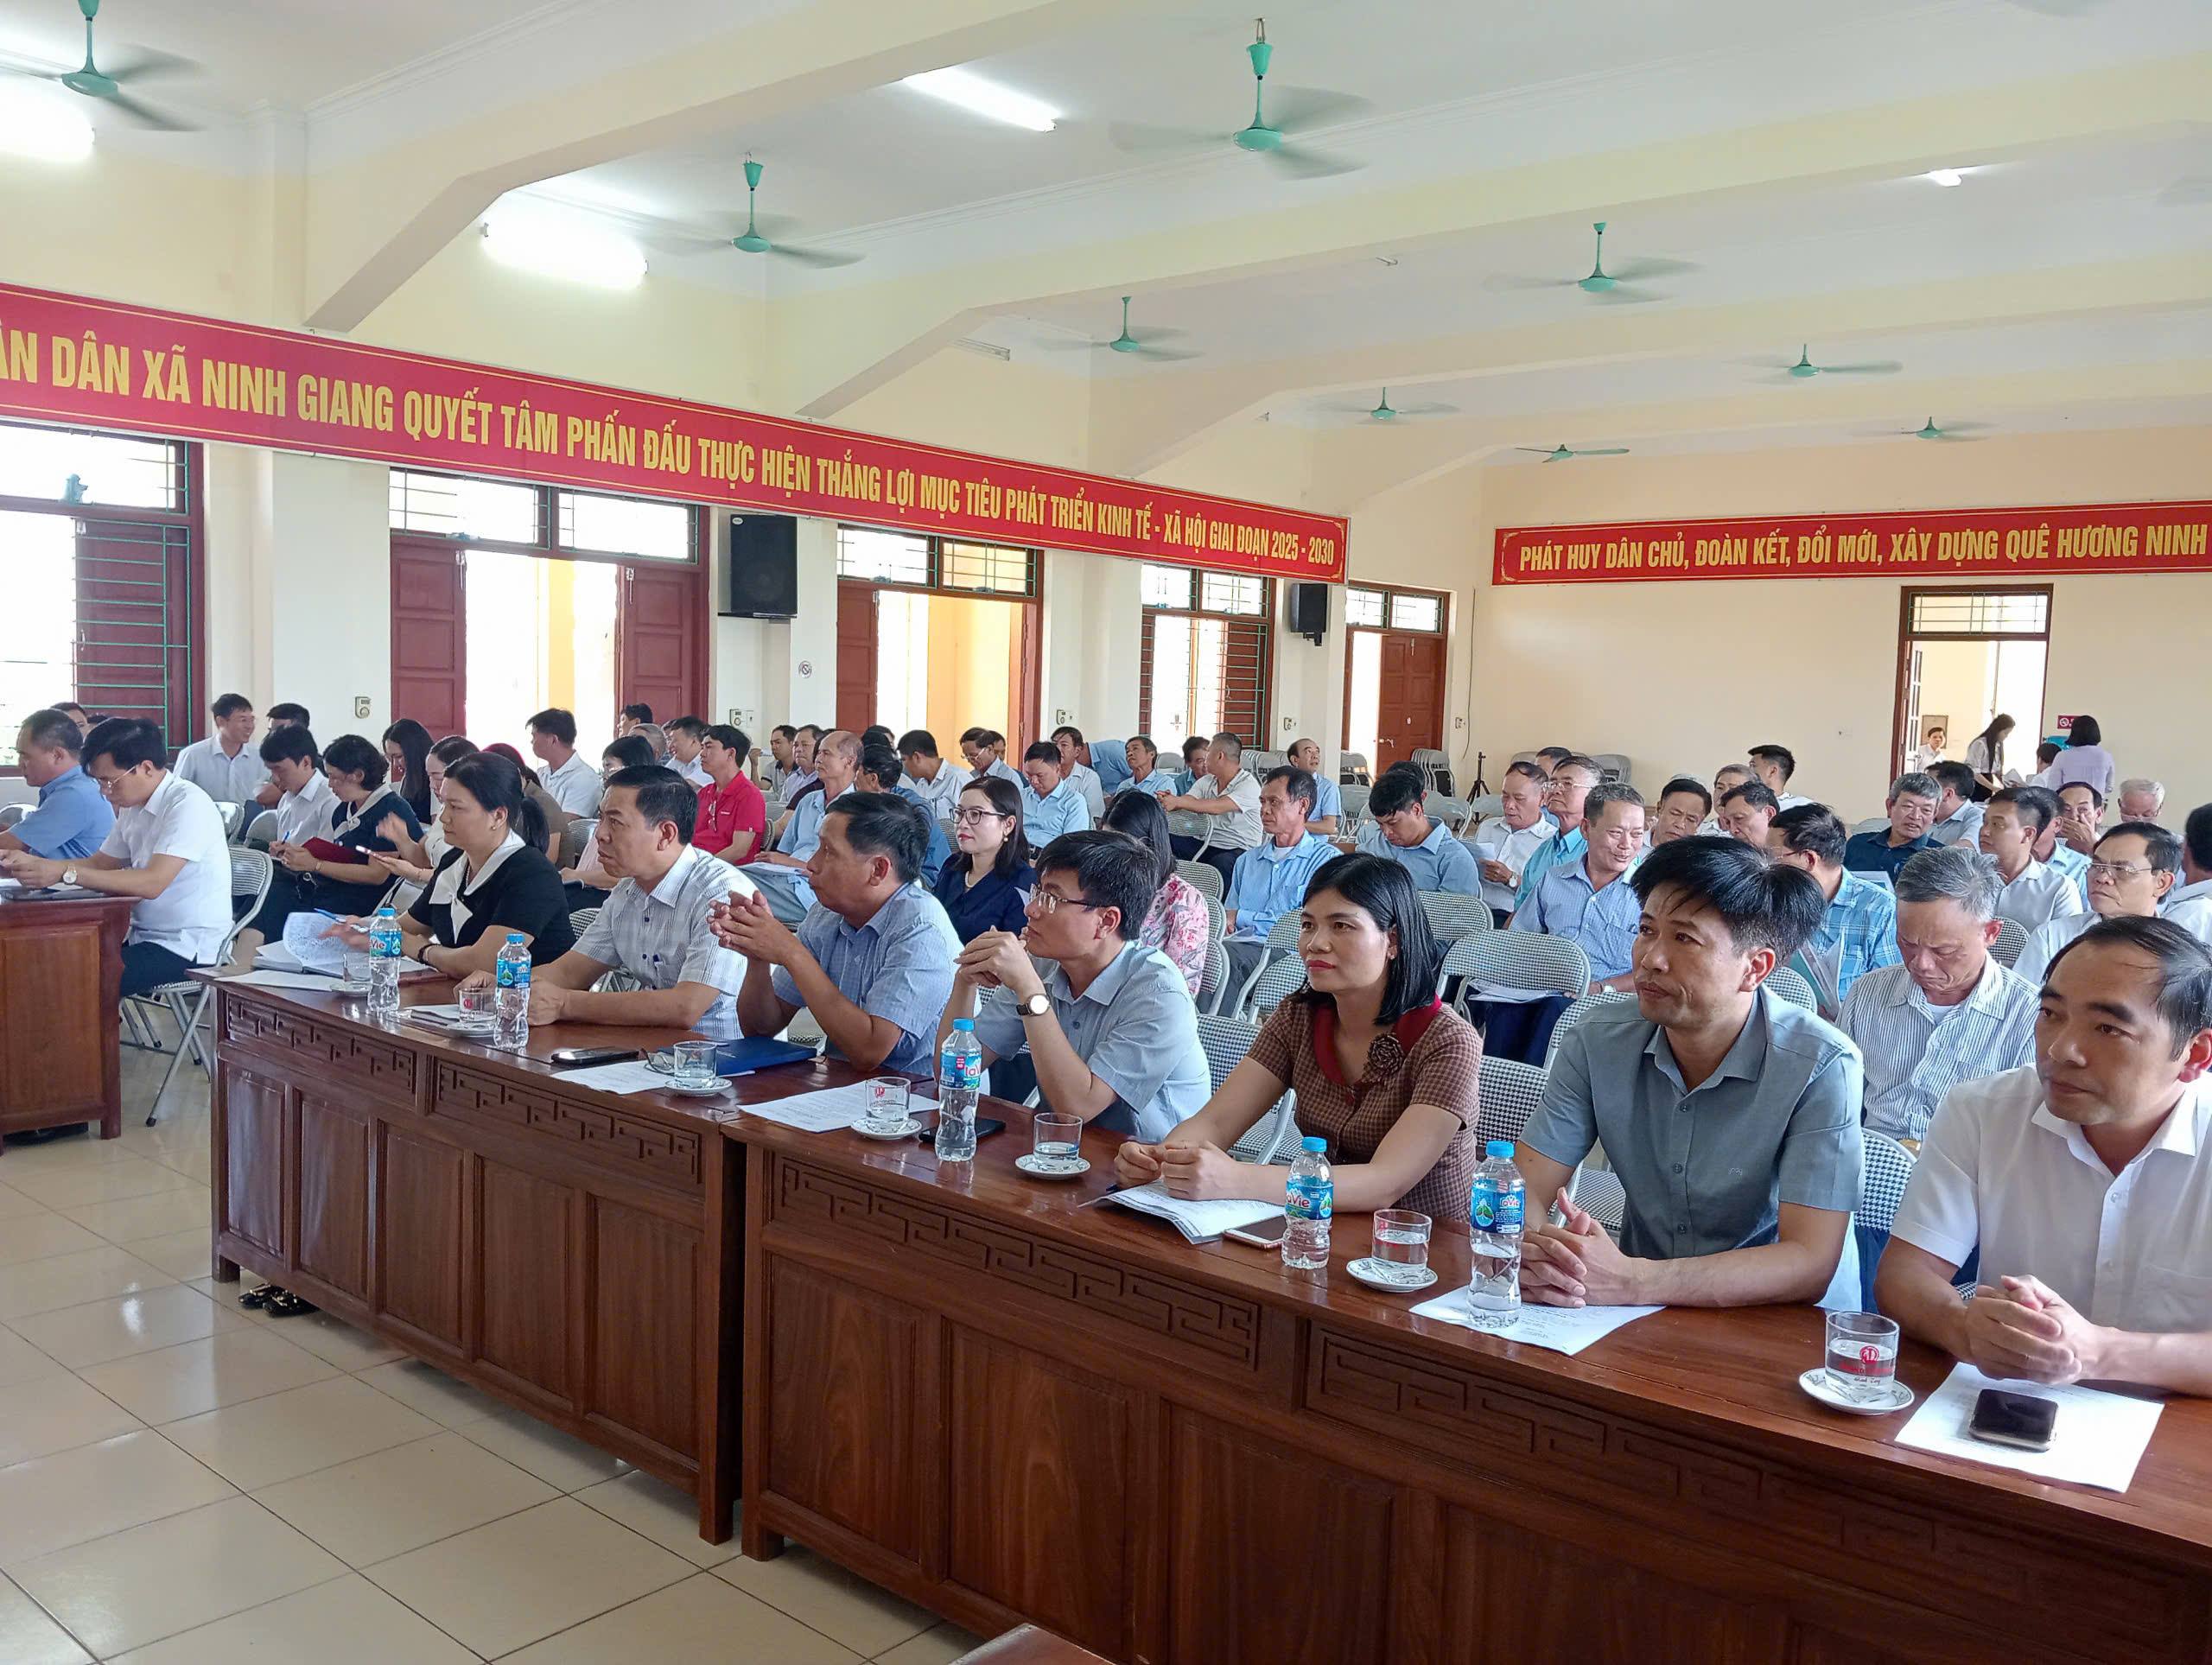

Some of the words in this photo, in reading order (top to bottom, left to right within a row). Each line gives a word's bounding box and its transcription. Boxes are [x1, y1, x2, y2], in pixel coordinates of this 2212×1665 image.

[52, 330, 130, 396] DÂN
[142, 344, 191, 404] XÃ
[202, 359, 286, 417] NINH
[297, 373, 394, 432] GIANG
[404, 387, 493, 445] QUYẾT
[500, 399, 558, 455] TÂM
[567, 409, 636, 467] PHẤN
[643, 419, 691, 474] ĐẤU
[698, 437, 755, 490] THỰC
[761, 444, 810, 499] HIỆN
[817, 449, 880, 503] THẮNG
[887, 468, 915, 514] LỢI
[920, 474, 961, 519] MỤC
[965, 477, 1001, 519] TIÊU
[1005, 485, 1047, 525] PHÁT
[1050, 486, 1095, 533] TRIỂN
[1096, 502, 1132, 538] KINH
[1135, 501, 1154, 541] TẾ
[1163, 509, 1182, 545] XÃ
[1185, 512, 1206, 554] HỘI
[1209, 520, 1235, 552] GIAI
[1236, 524, 1269, 562] ĐOẠN
[1270, 531, 1299, 562] 2025
[1307, 537, 1335, 566] 2030
[1519, 536, 1563, 572] PHÁT
[1567, 543, 1602, 570] HUY
[1605, 537, 1643, 569] DÂN
[1648, 531, 1690, 571] CHỦ,
[1694, 532, 1749, 567] ĐOÀN
[1752, 528, 1791, 568] KẾT,
[1796, 524, 1832, 564] ĐỔI
[1837, 529, 1883, 566] MỚI,
[1889, 527, 1933, 562] XÂY
[1937, 528, 1999, 568] DỰNG
[2005, 523, 2051, 563] QUÊ
[2056, 524, 2139, 558] HƯƠNG
[2145, 524, 2209, 556] NINH
[370, 937, 385, 950] Vie
